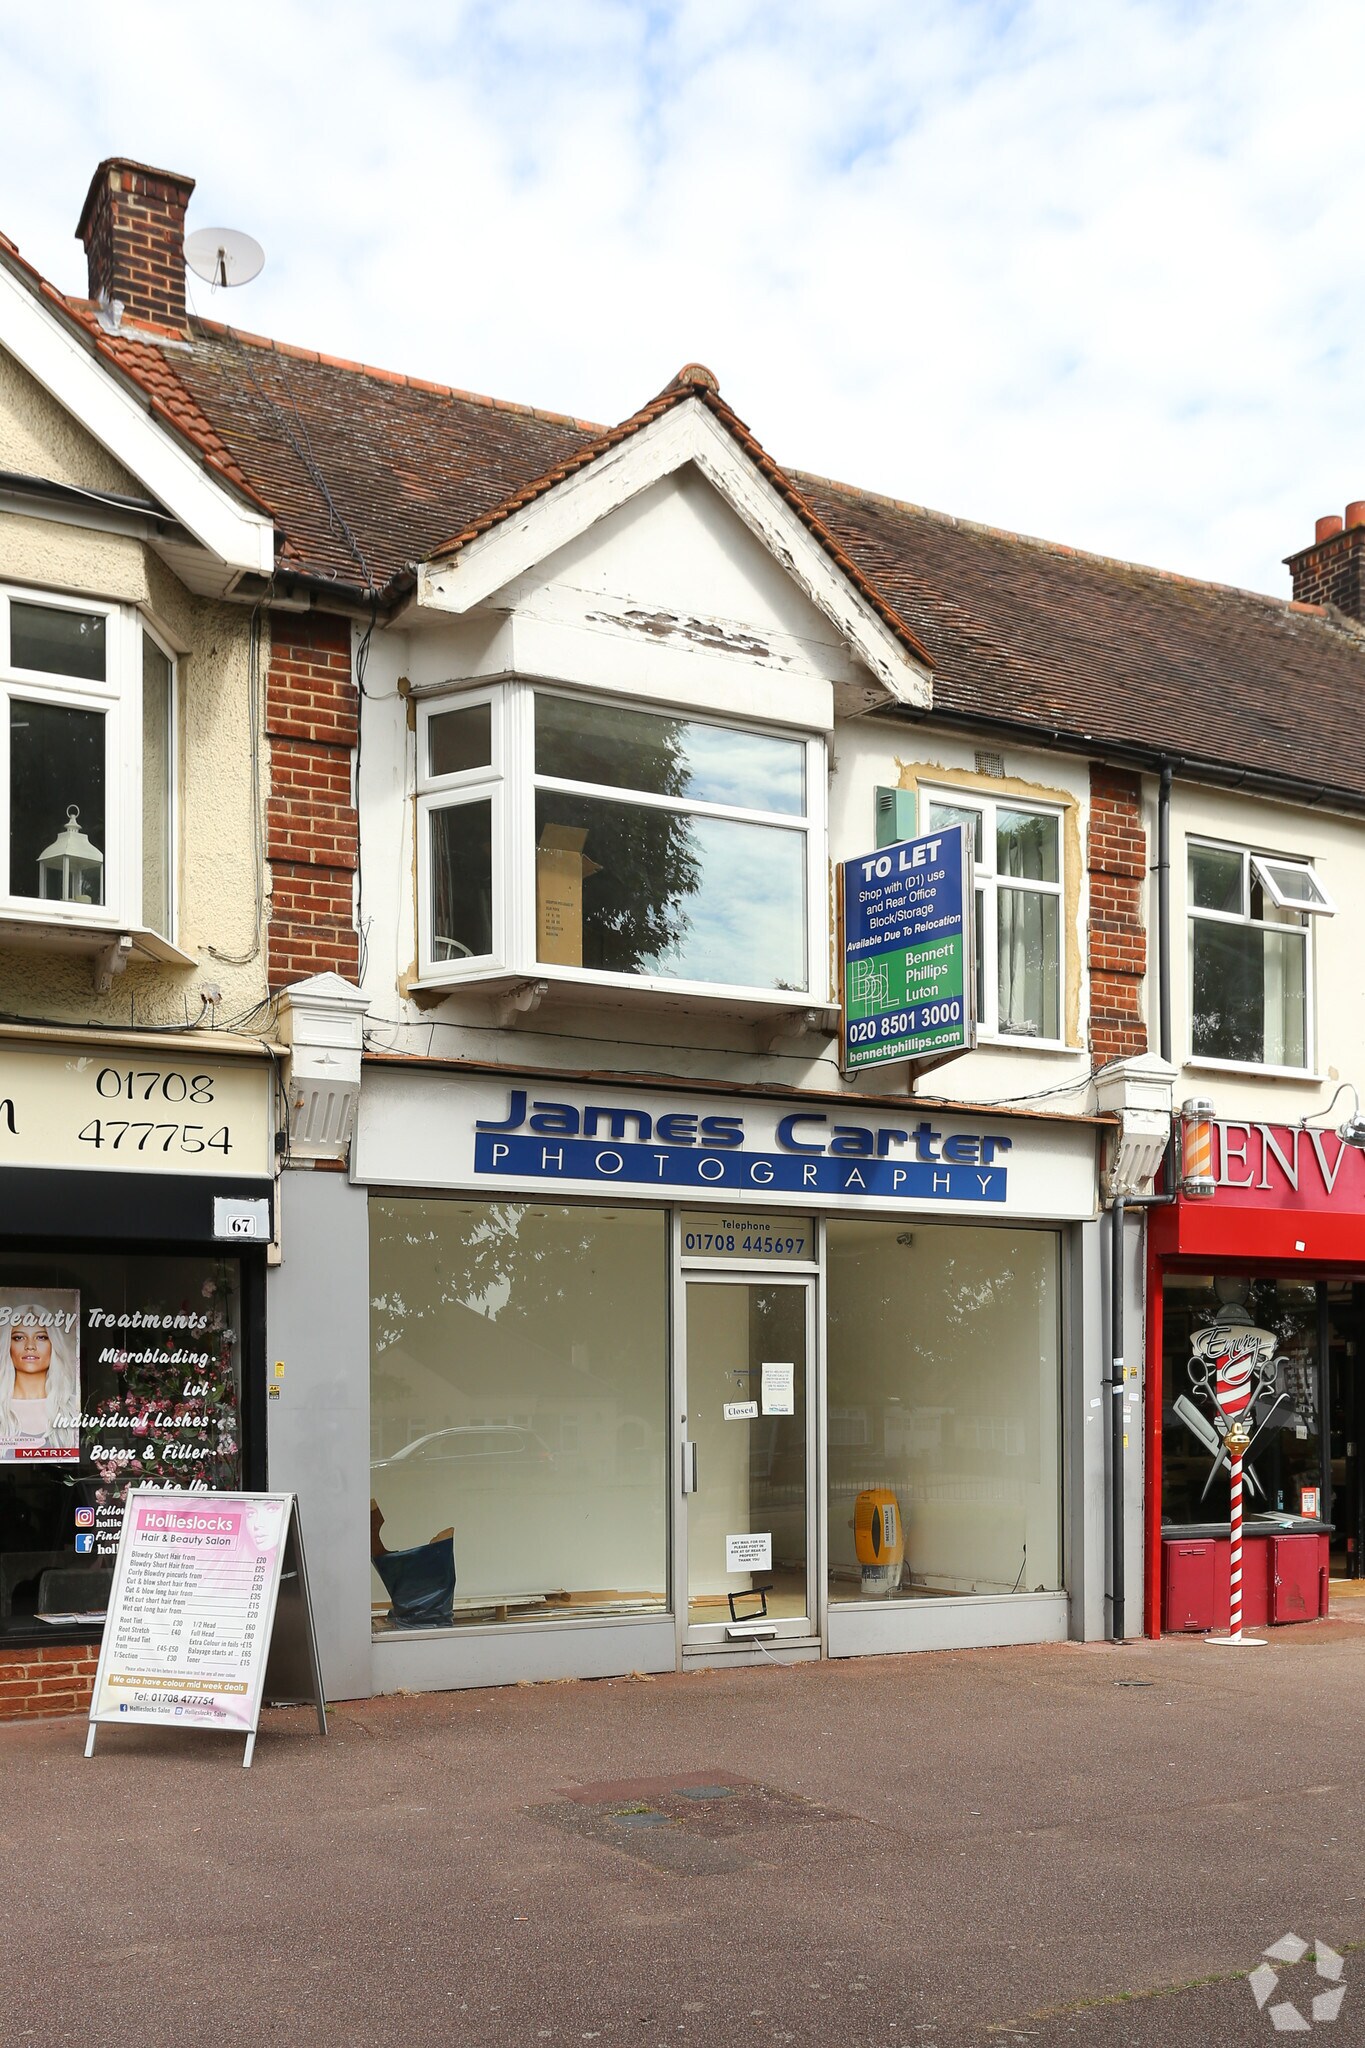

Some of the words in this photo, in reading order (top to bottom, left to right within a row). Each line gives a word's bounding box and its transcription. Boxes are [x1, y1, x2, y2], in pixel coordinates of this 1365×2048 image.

[862, 855, 892, 882] TO
[899, 839, 942, 872] LET
[858, 889, 882, 903] Shop
[884, 881, 902, 895] with
[905, 873, 925, 890] (D1)
[927, 870, 945, 882] use
[866, 902, 883, 915] and
[886, 895, 907, 910] Rear
[909, 887, 937, 903] Office
[870, 903, 934, 929] Block/Storage
[847, 935, 882, 952] Available
[884, 930, 900, 942] Due
[903, 926, 912, 937] To
[914, 914, 961, 934] Relocation
[905, 942, 954, 967] Bennett
[905, 964, 948, 984] Phillips
[906, 984, 939, 1002] Luton
[849, 1020, 876, 1043] 020
[881, 1010, 915, 1037] 8501
[921, 1001, 960, 1027] 3000
[849, 1031, 961, 1063] bennettphillips.com
[96, 1067, 214, 1104] 01708
[475, 1089, 745, 1147] James
[776, 1113, 1012, 1163] Carter
[78, 1119, 233, 1155] 477754
[1213, 1120, 1365, 1198] ENV
[492, 1142, 993, 1195] PHOTOGRAPHY
[231, 1218, 250, 1233] 67
[721, 1219, 771, 1232] Telephone
[685, 1233, 735, 1251] 01708
[742, 1236, 805, 1254] 445697
[0, 1305, 77, 1334] Beauty
[88, 1308, 208, 1330] Treatments
[99, 1348, 209, 1368] Microblading
[1196, 1325, 1278, 1386] Envy
[728, 1406, 754, 1416] Closed
[53, 1412, 148, 1429] Individual
[155, 1412, 209, 1429] Lashes
[22, 1449, 72, 1457] MATRIX
[90, 1444, 136, 1461] Botox
[142, 1444, 155, 1461] &
[162, 1444, 209, 1461] Filler
[145, 1513, 233, 1531] Hollieslocks
[141, 1533, 159, 1542] Hair
[162, 1534, 168, 1542] &
[171, 1535, 203, 1546] Beauty
[205, 1536, 231, 1546] Salon
[131, 1551, 153, 1559] Blowdry
[128, 1568, 143, 1577] Curly
[144, 1569, 165, 1578] Blowdry
[166, 1571, 188, 1579] pincurls
[130, 1560, 151, 1568] Blowdry
[153, 1561, 167, 1569] Short
[144, 1606, 155, 1614] long
[131, 1626, 150, 1634] Stretch
[188, 1647, 211, 1656] Balayage
[203, 1639, 220, 1647] Colour
[114, 1651, 138, 1659] T/Section
[113, 1675, 124, 1683] We
[142, 1678, 161, 1686] have
[162, 1680, 185, 1688] colour
[187, 1681, 201, 1689] mid
[202, 1682, 223, 1690] week
[224, 1683, 244, 1691] deals
[134, 1692, 149, 1701] Tel:
[151, 1693, 179, 1703] 01708
[181, 1695, 215, 1706] 477754
[158, 1706, 171, 1714] Salon
